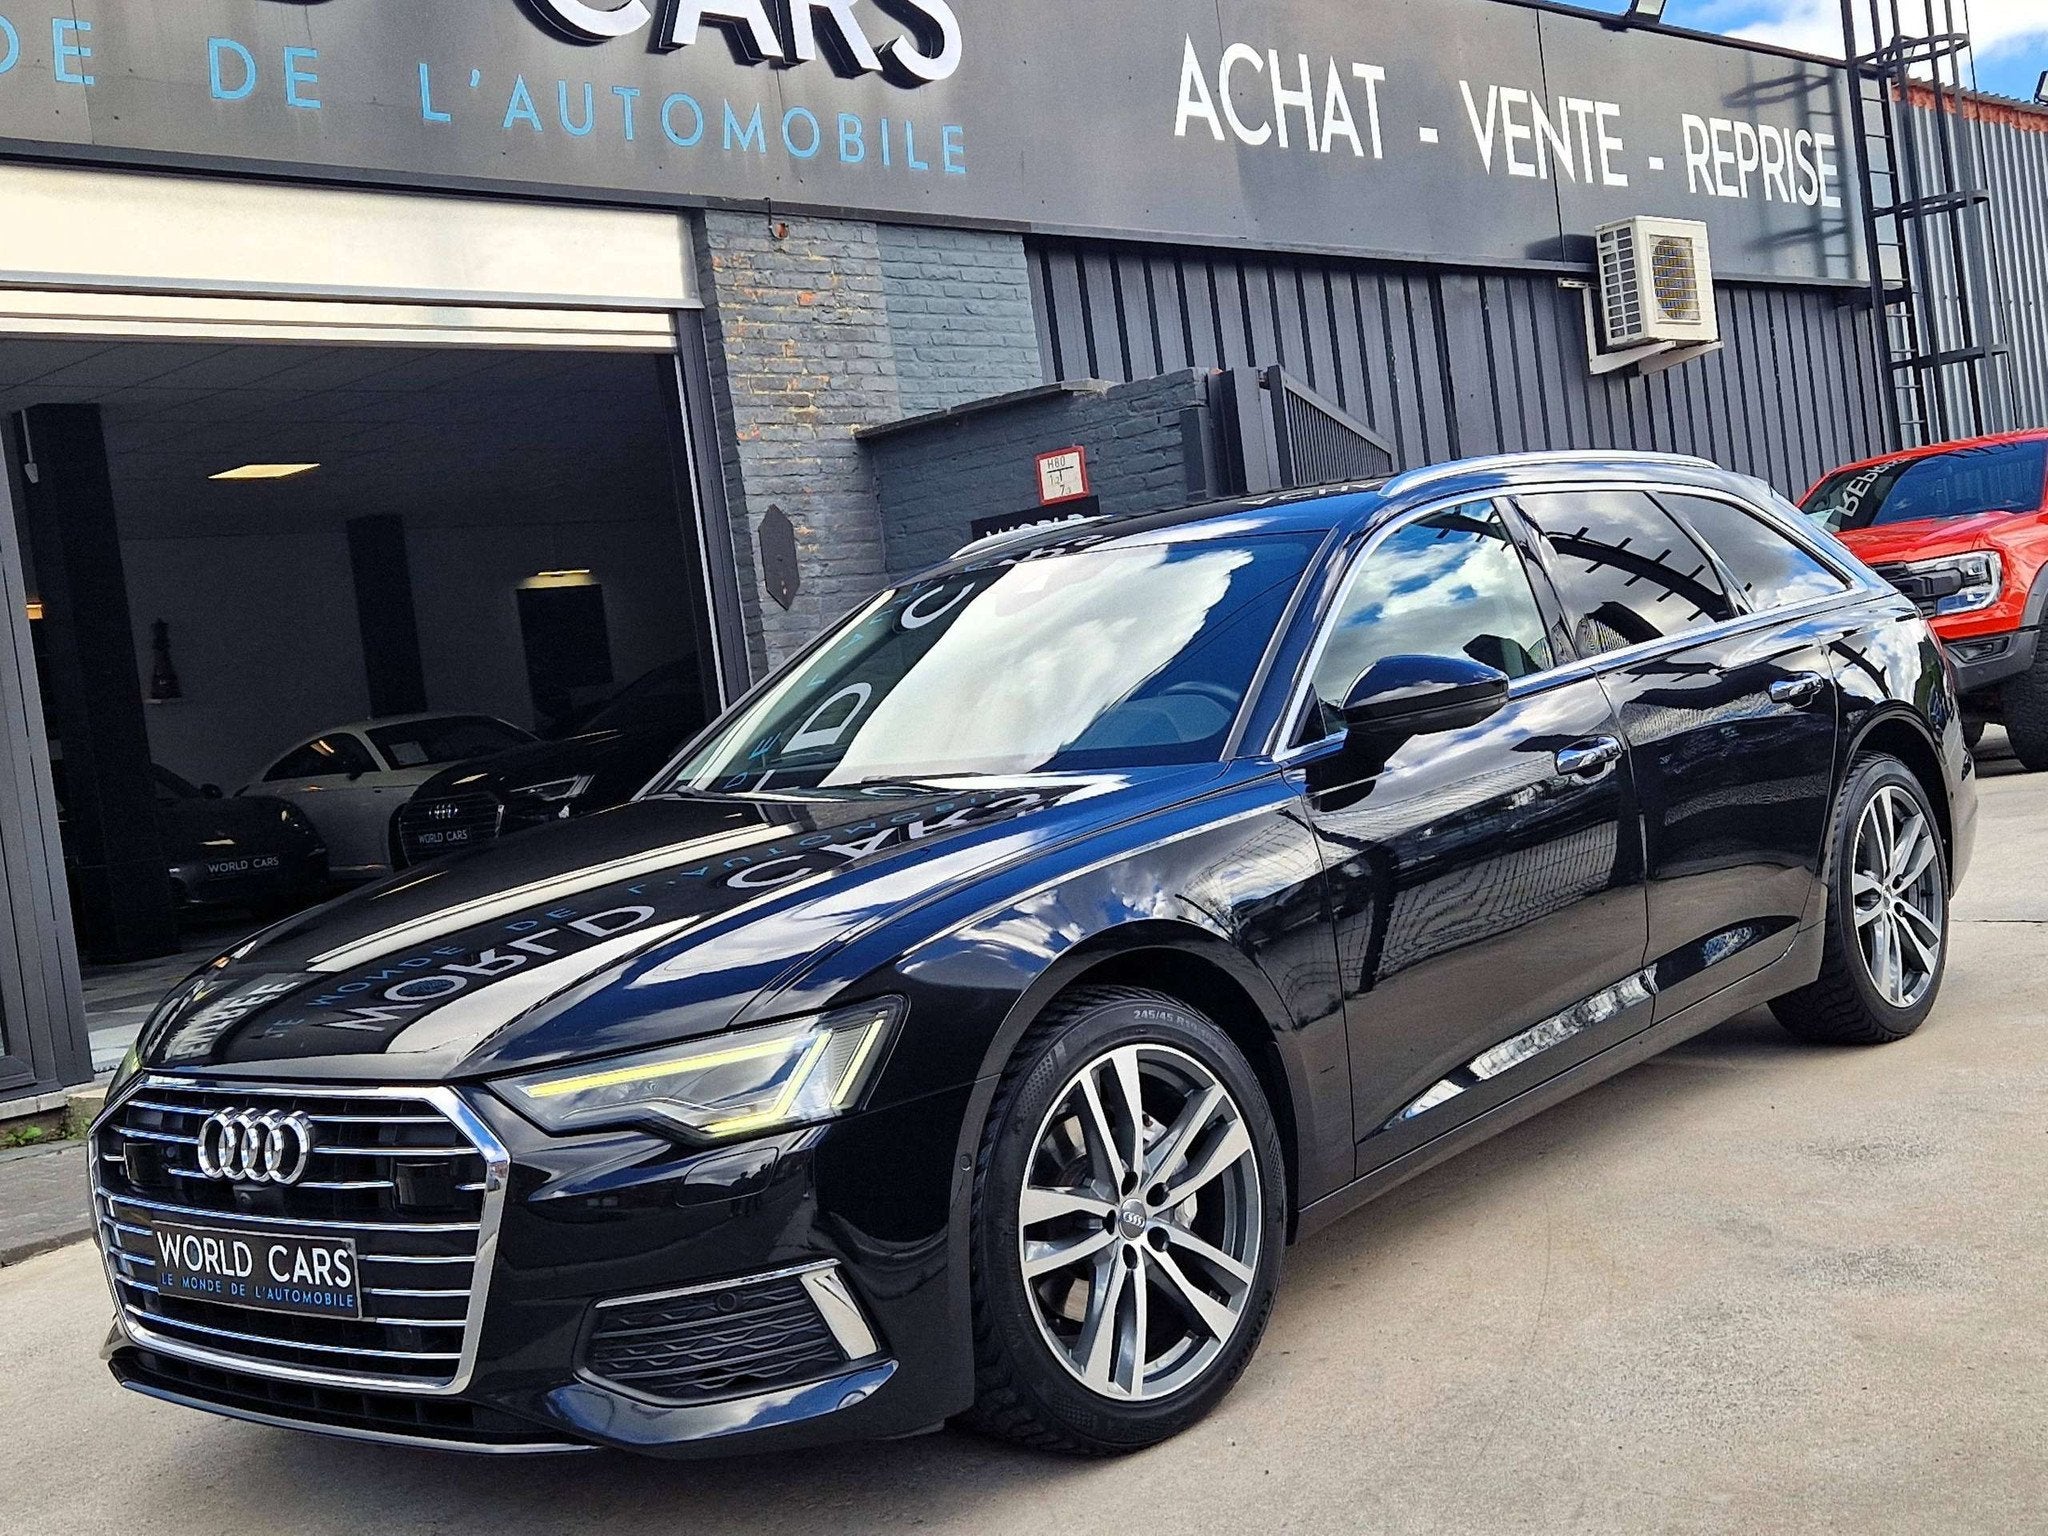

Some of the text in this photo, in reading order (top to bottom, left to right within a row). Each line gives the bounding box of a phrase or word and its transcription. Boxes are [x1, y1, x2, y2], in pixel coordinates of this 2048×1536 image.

[207, 36, 322, 109] DE
[419, 62, 967, 175] L'AUTOMOBILE
[1174, 32, 1842, 208] ACHAT - VENTE - REPRISE
[418, 829, 468, 845] WORLD CARS
[208, 856, 279, 875] WORLD CARS
[1133, 1009, 1174, 1022] 245/45
[157, 1231, 352, 1287] WORLD CARS
[161, 1273, 354, 1308] LE MONDE DE L'AUTOMOBILE
